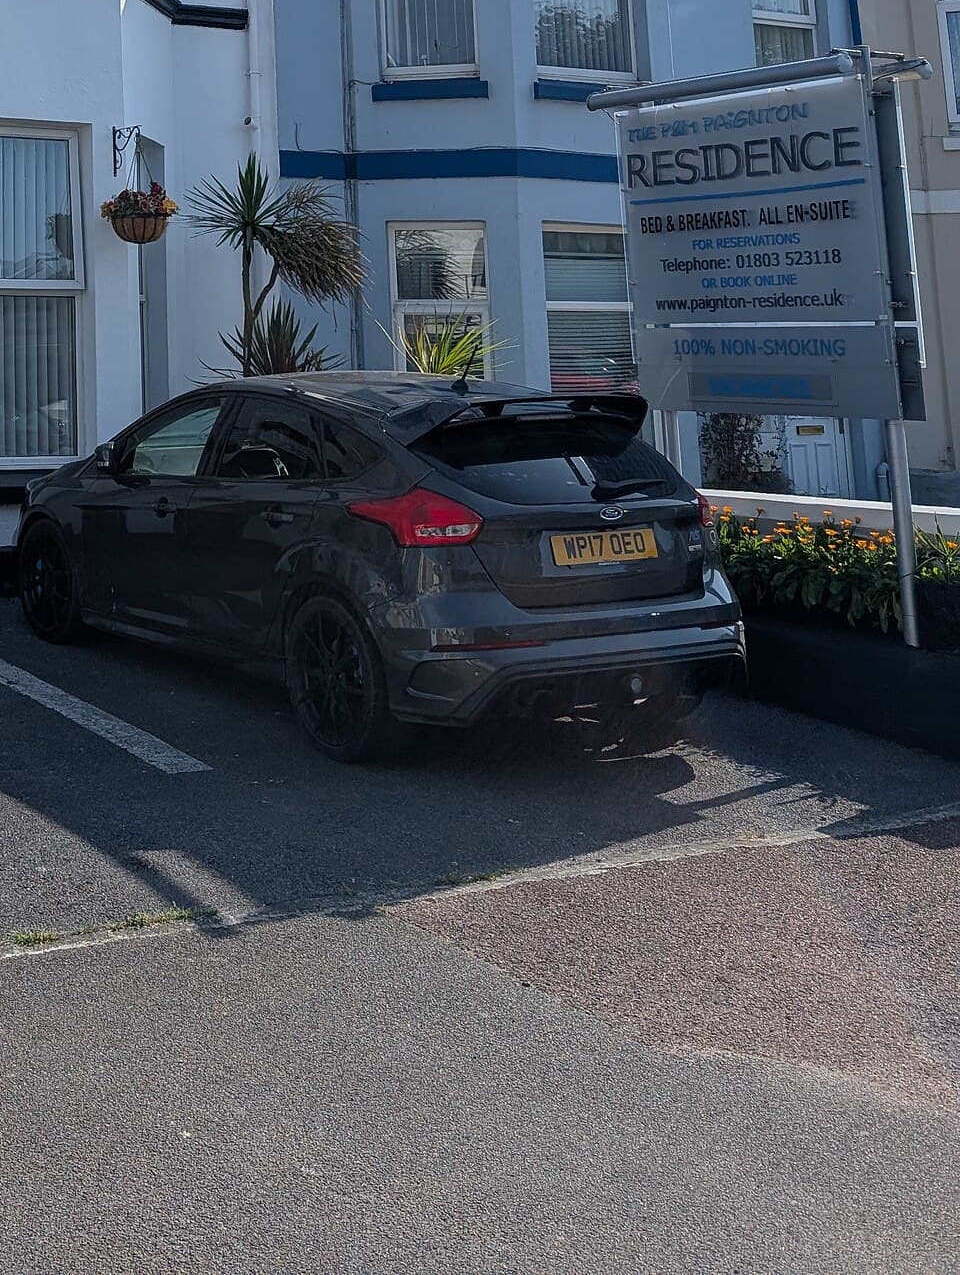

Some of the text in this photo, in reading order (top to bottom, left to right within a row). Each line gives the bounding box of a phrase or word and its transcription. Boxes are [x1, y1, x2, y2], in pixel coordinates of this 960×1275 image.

[626, 102, 808, 143] THE P&M PAIGNTON
[626, 126, 862, 190] RESIDENCE
[640, 199, 851, 234] BED & BREAKFAST. ALL EN-SUITE
[692, 232, 801, 251] FOR RESERVATIONS
[660, 249, 842, 275] Telephone: 01803 523118
[701, 273, 798, 289] OR BOOK ONLINE
[656, 288, 844, 313] www.paignton-residence.uk
[673, 338, 846, 357] 100% NON-SMOKING
[563, 532, 647, 560] WP17 OEO
